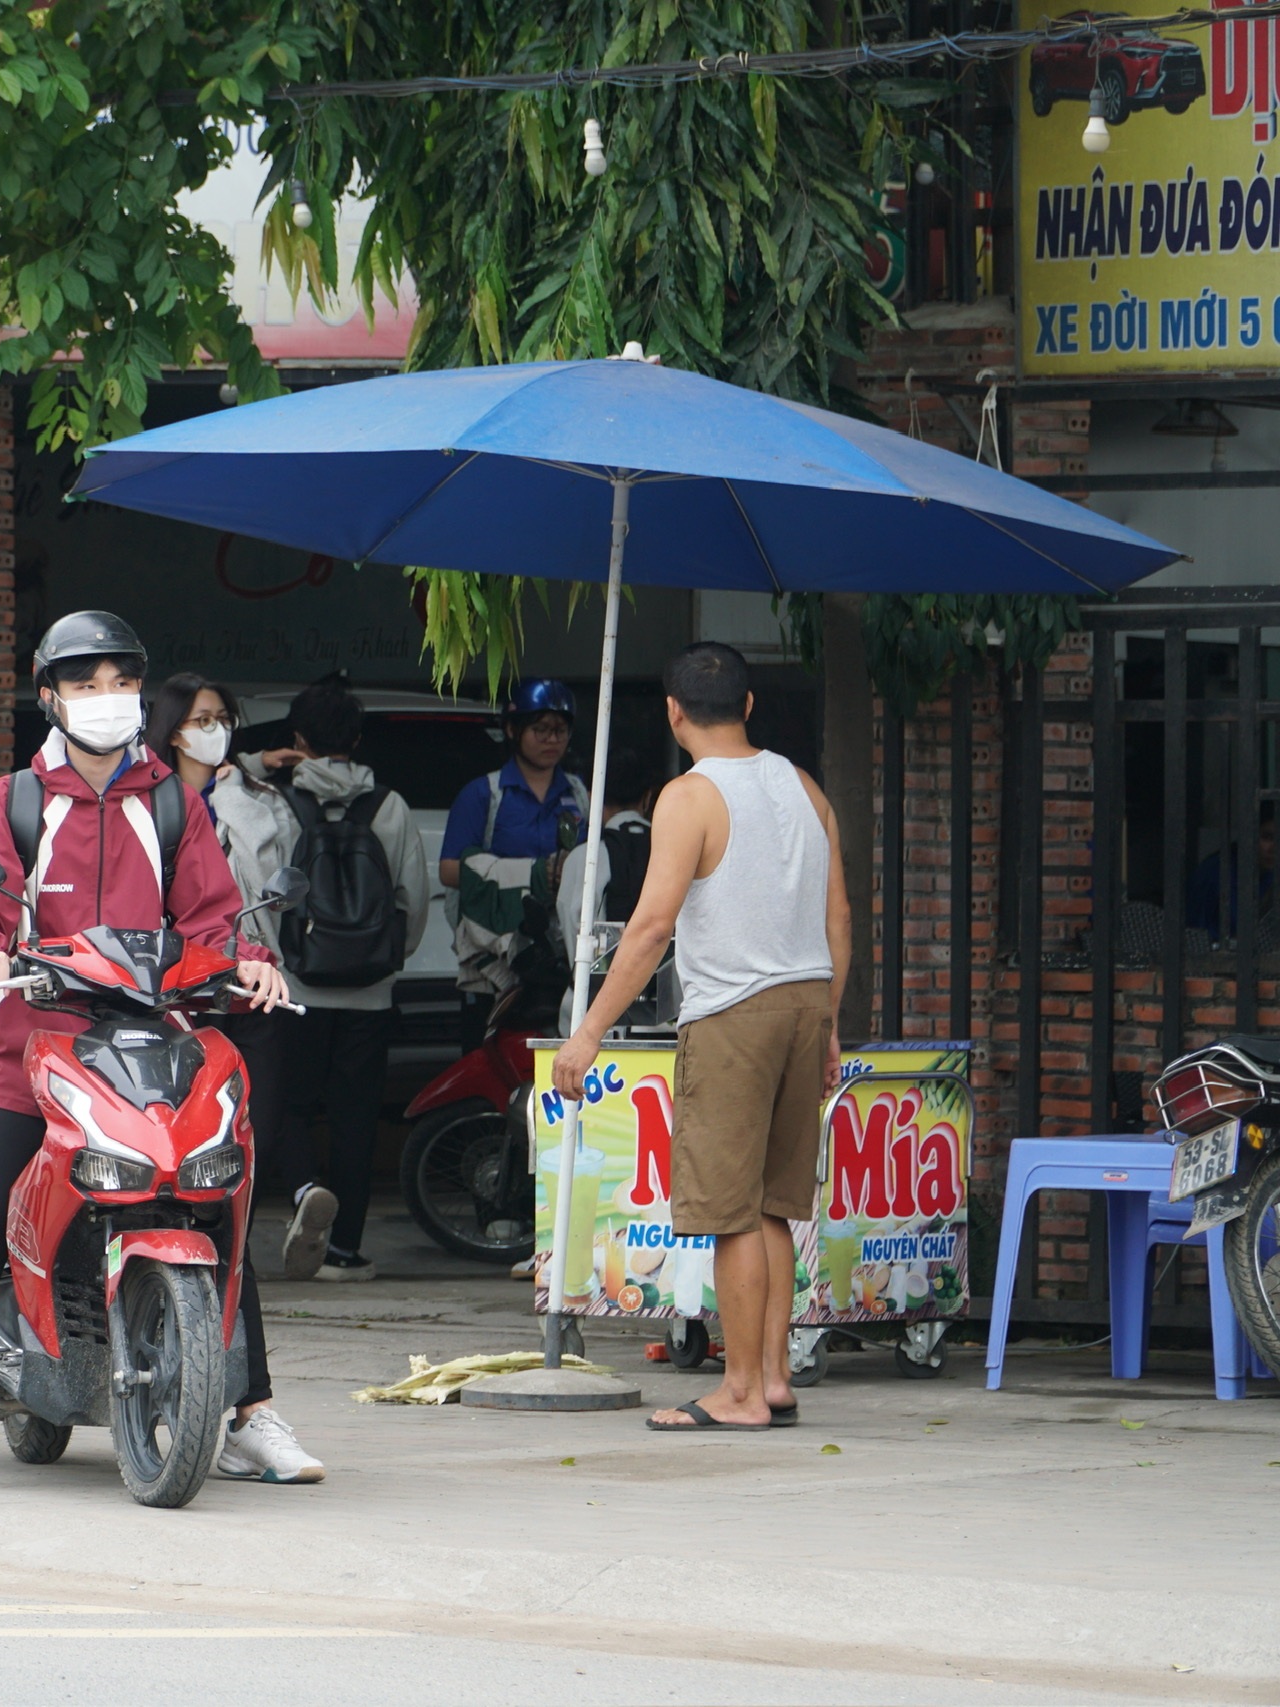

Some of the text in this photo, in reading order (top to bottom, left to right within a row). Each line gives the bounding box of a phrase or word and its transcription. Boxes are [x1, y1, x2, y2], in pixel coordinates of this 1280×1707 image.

[1210, 0, 1280, 146] DỊ
[1035, 164, 1134, 282] NHẬN
[1139, 165, 1211, 255] ĐƯA
[1035, 304, 1079, 354] XE
[1090, 290, 1148, 352] ĐỜI
[1160, 288, 1228, 350] MỚI
[1239, 298, 1261, 347] 5
[828, 1089, 963, 1220] Mía
[862, 1225, 956, 1262] NGUYÊN CHẤT
